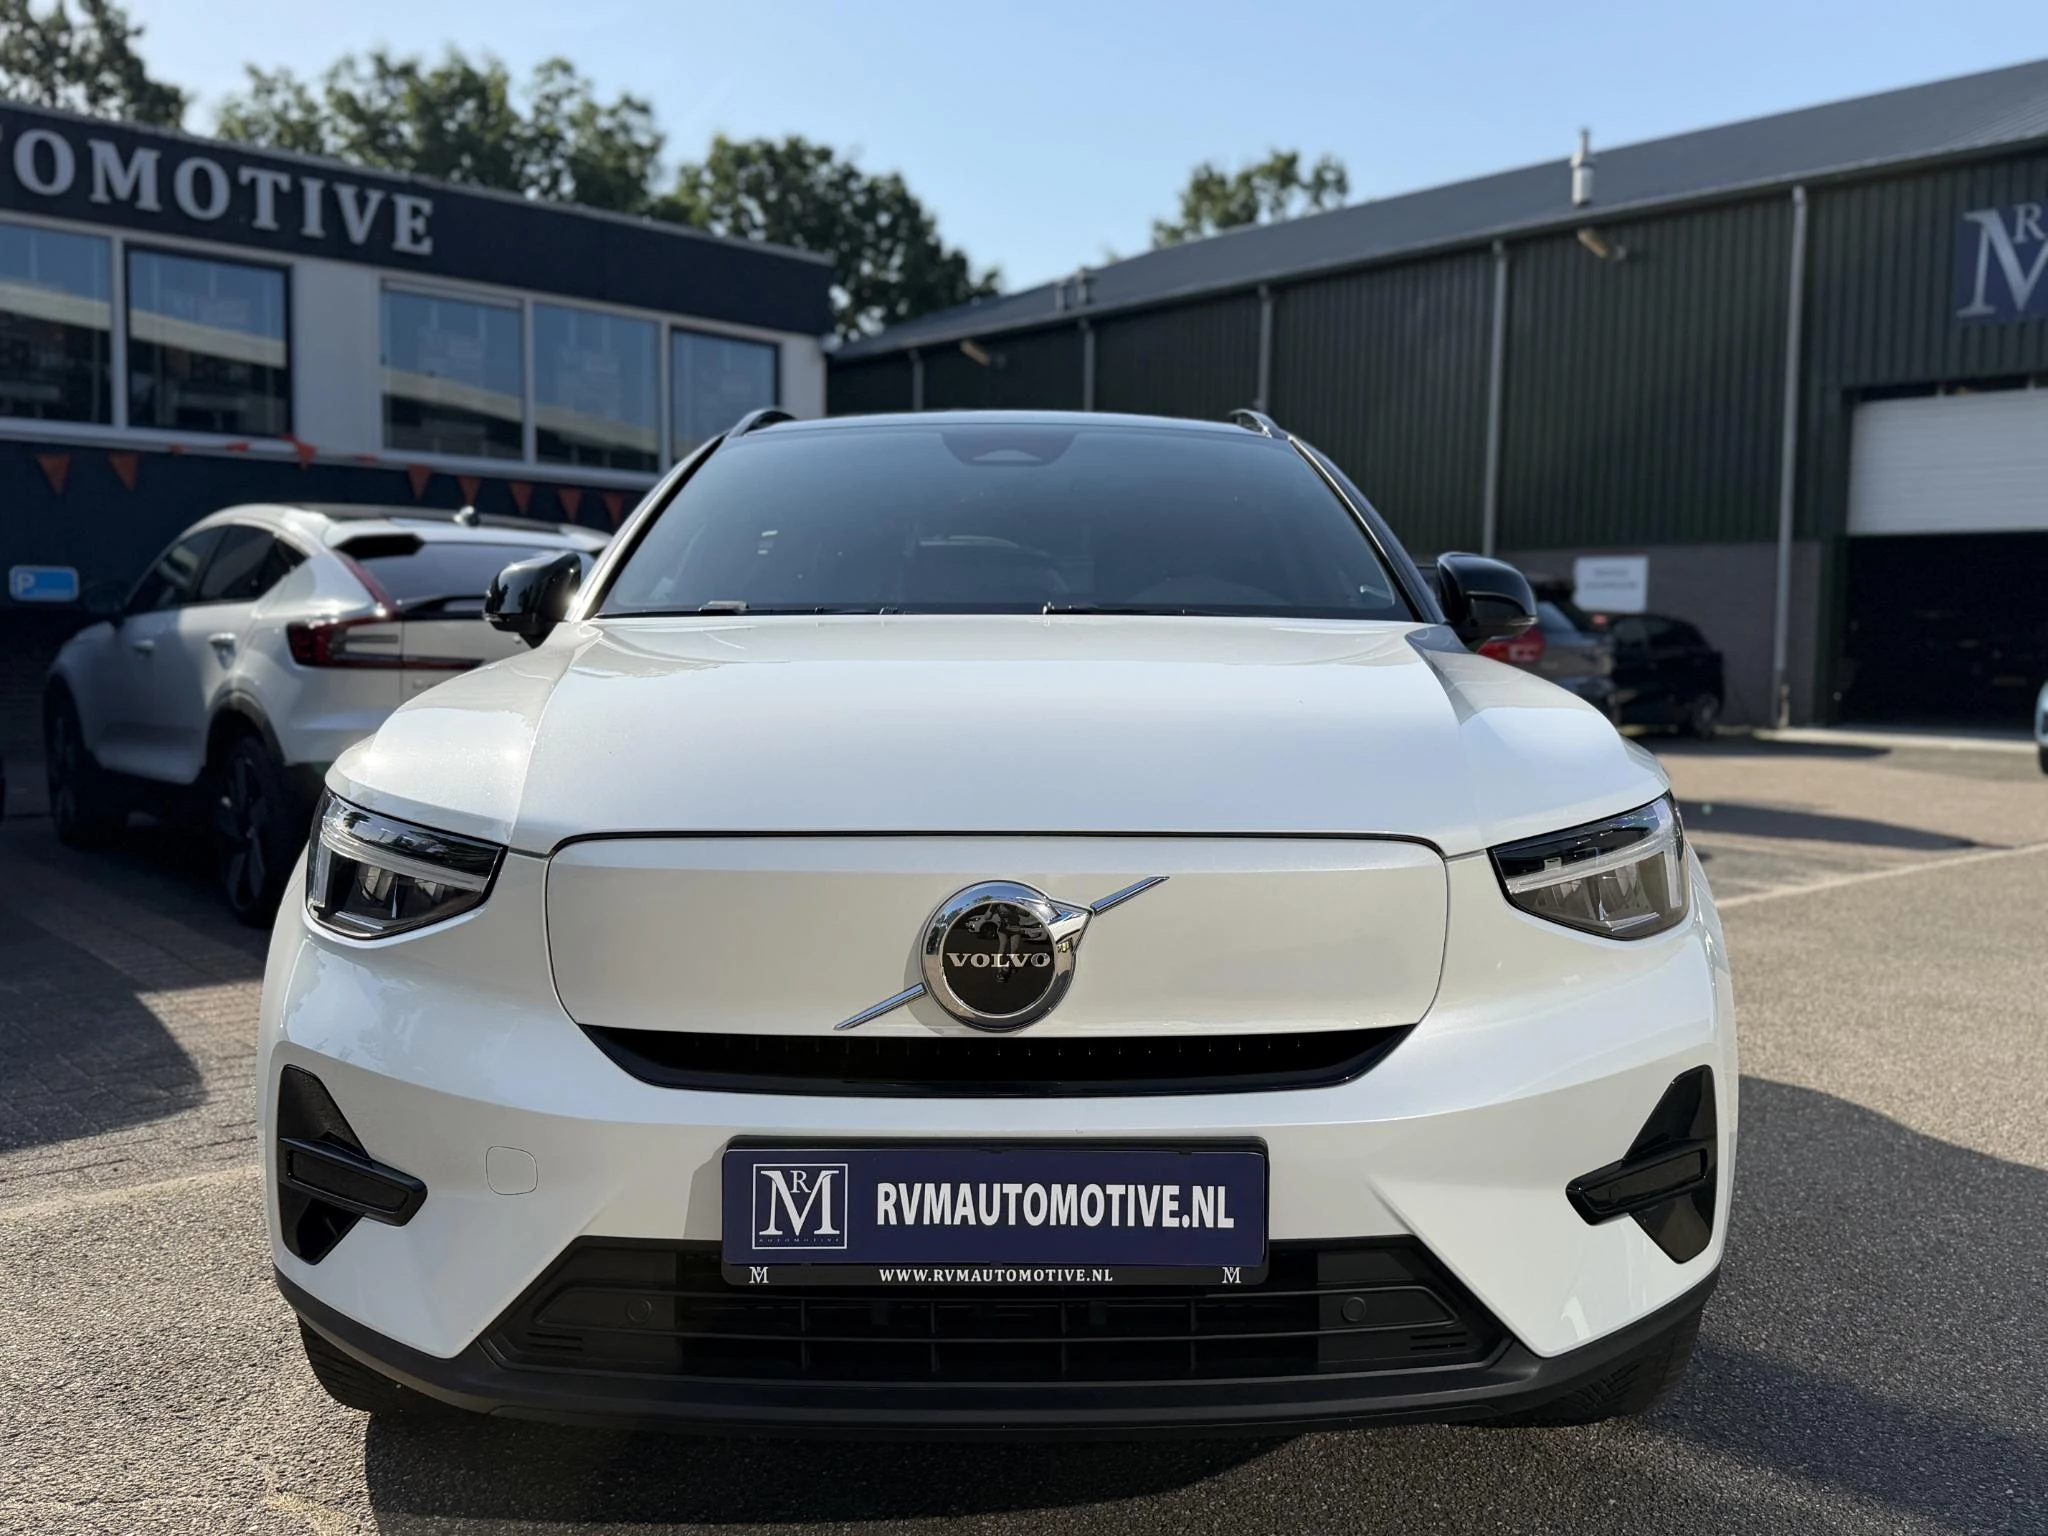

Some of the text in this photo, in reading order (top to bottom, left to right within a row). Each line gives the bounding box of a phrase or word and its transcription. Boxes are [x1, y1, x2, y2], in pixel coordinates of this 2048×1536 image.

[0, 123, 435, 256] OMOTIVE
[946, 952, 1051, 968] VOLVO
[876, 1182, 1235, 1229] RVMAUTOMOTIVE.NL
[879, 1268, 1113, 1282] WWW.RVMAUTOMOTIVE.NL
